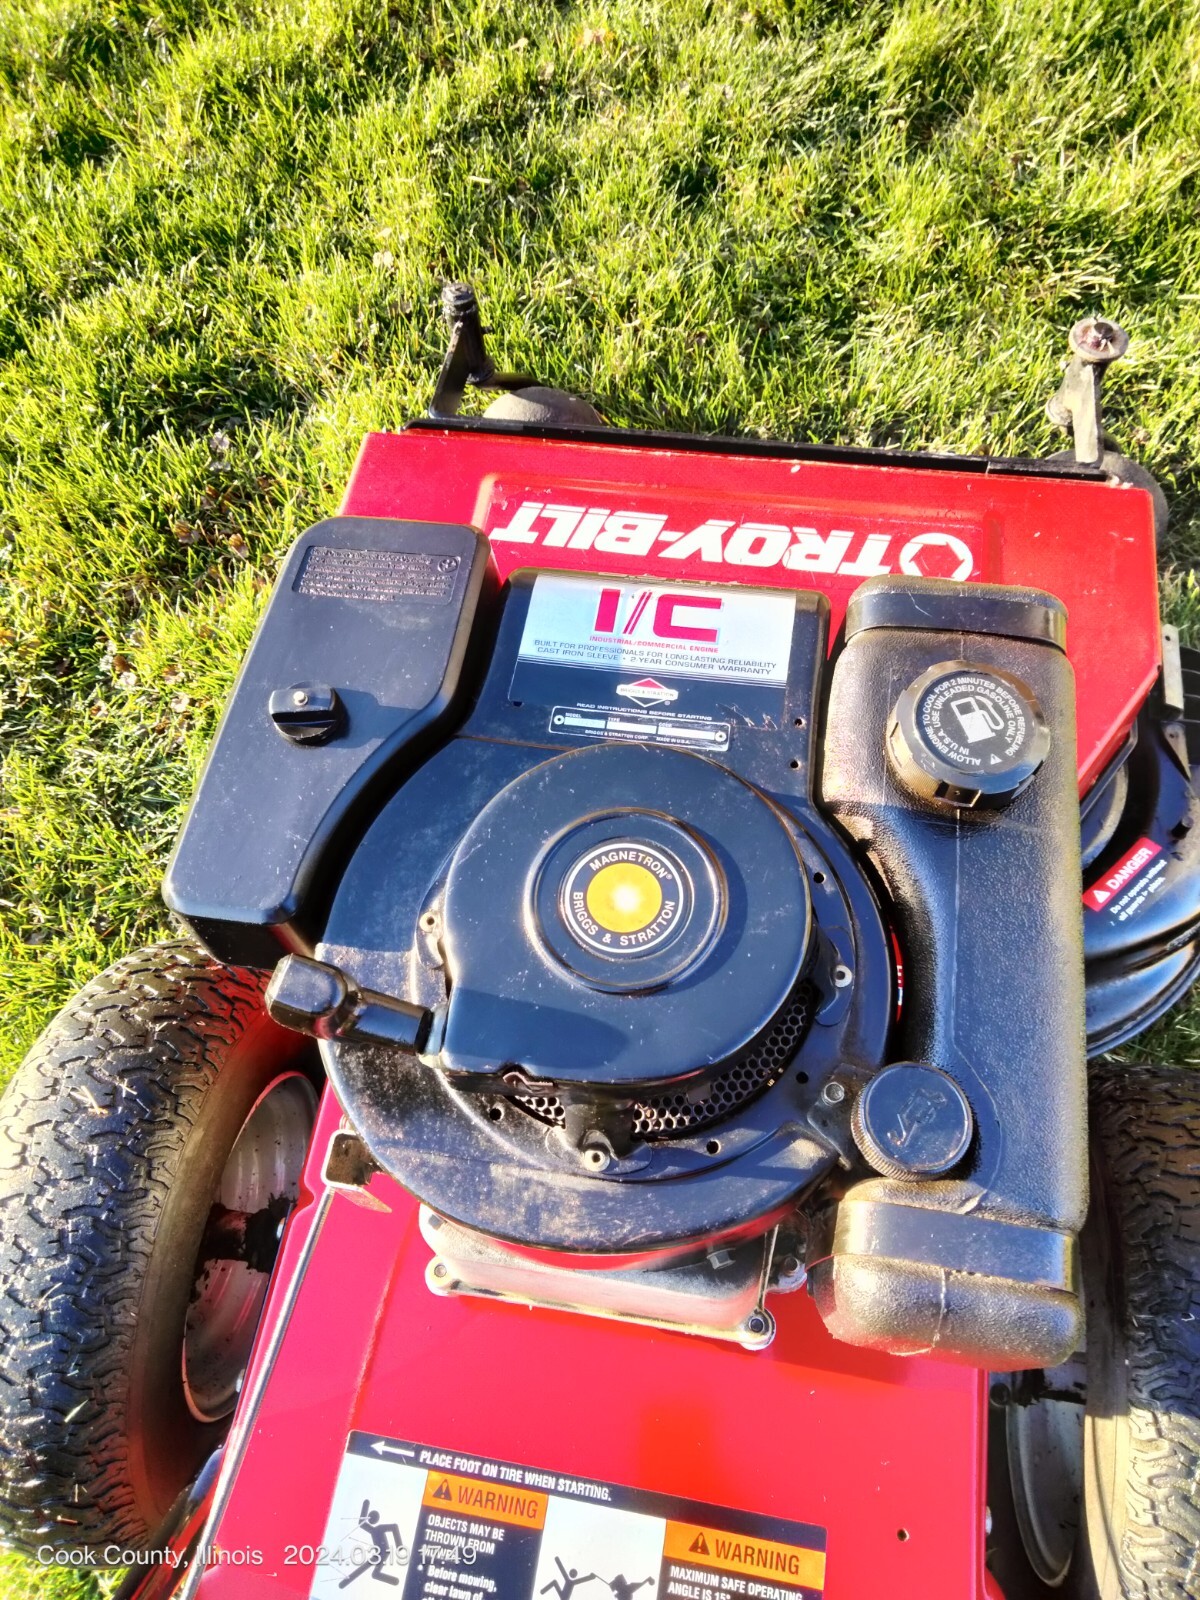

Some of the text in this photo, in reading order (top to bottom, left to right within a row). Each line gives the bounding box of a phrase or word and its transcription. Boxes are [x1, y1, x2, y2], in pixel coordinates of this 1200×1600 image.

[487, 501, 893, 577] TROY-BILT
[534, 639, 557, 648] BUILT
[578, 644, 644, 656] PROFESSIONALS
[665, 653, 688, 661] LONG
[690, 655, 725, 664] LASTING
[728, 657, 776, 669] RELIABILITY
[590, 636, 686, 650] INDUSTRIAL/COMMERCIAL
[537, 646, 560, 655] CAST
[562, 649, 584, 657] IRON
[587, 651, 619, 661] SLEEVE
[665, 659, 714, 670] CONSUMER
[718, 664, 772, 675] WARRANTY
[934, 682, 951, 694] FOR
[957, 677, 996, 690] MINUTES
[923, 694, 937, 713] COOL
[933, 685, 974, 709] UNLEADED
[977, 686, 1014, 719] GASOLINE
[996, 686, 1022, 716] BEFORE
[597, 705, 647, 714] INSTRUCTIONS
[649, 710, 675, 718] BEFORE
[677, 713, 712, 721] STARTING
[923, 714, 930, 726] TO
[932, 711, 941, 727] USE
[925, 726, 949, 754] ENGINE
[1005, 720, 1016, 743] ONLY
[1005, 716, 1026, 757] REFUELING
[948, 751, 981, 766] ALLOW
[959, 746, 969, 755] IN
[1106, 847, 1153, 890] DANGER
[1110, 860, 1167, 914] Do not operate without
[573, 891, 676, 946] BRIGGS & STRATTON
[420, 1451, 612, 1501] PLACE FOOT ON TIRE WHEN STARTING.
[458, 1486, 539, 1519] WARNING
[428, 1514, 505, 1541] OBJECTS MAY BE
[425, 1529, 495, 1555] THROWN FROM
[715, 1539, 800, 1575] WARNING
[428, 1564, 457, 1583] Before
[670, 1565, 803, 1600] MAXIMUM SAFE OPERATING
[424, 1581, 449, 1596] clear
[449, 1587, 471, 1600] lawn
[667, 1582, 701, 1600] ANGLE
[702, 1589, 711, 1600] IS
